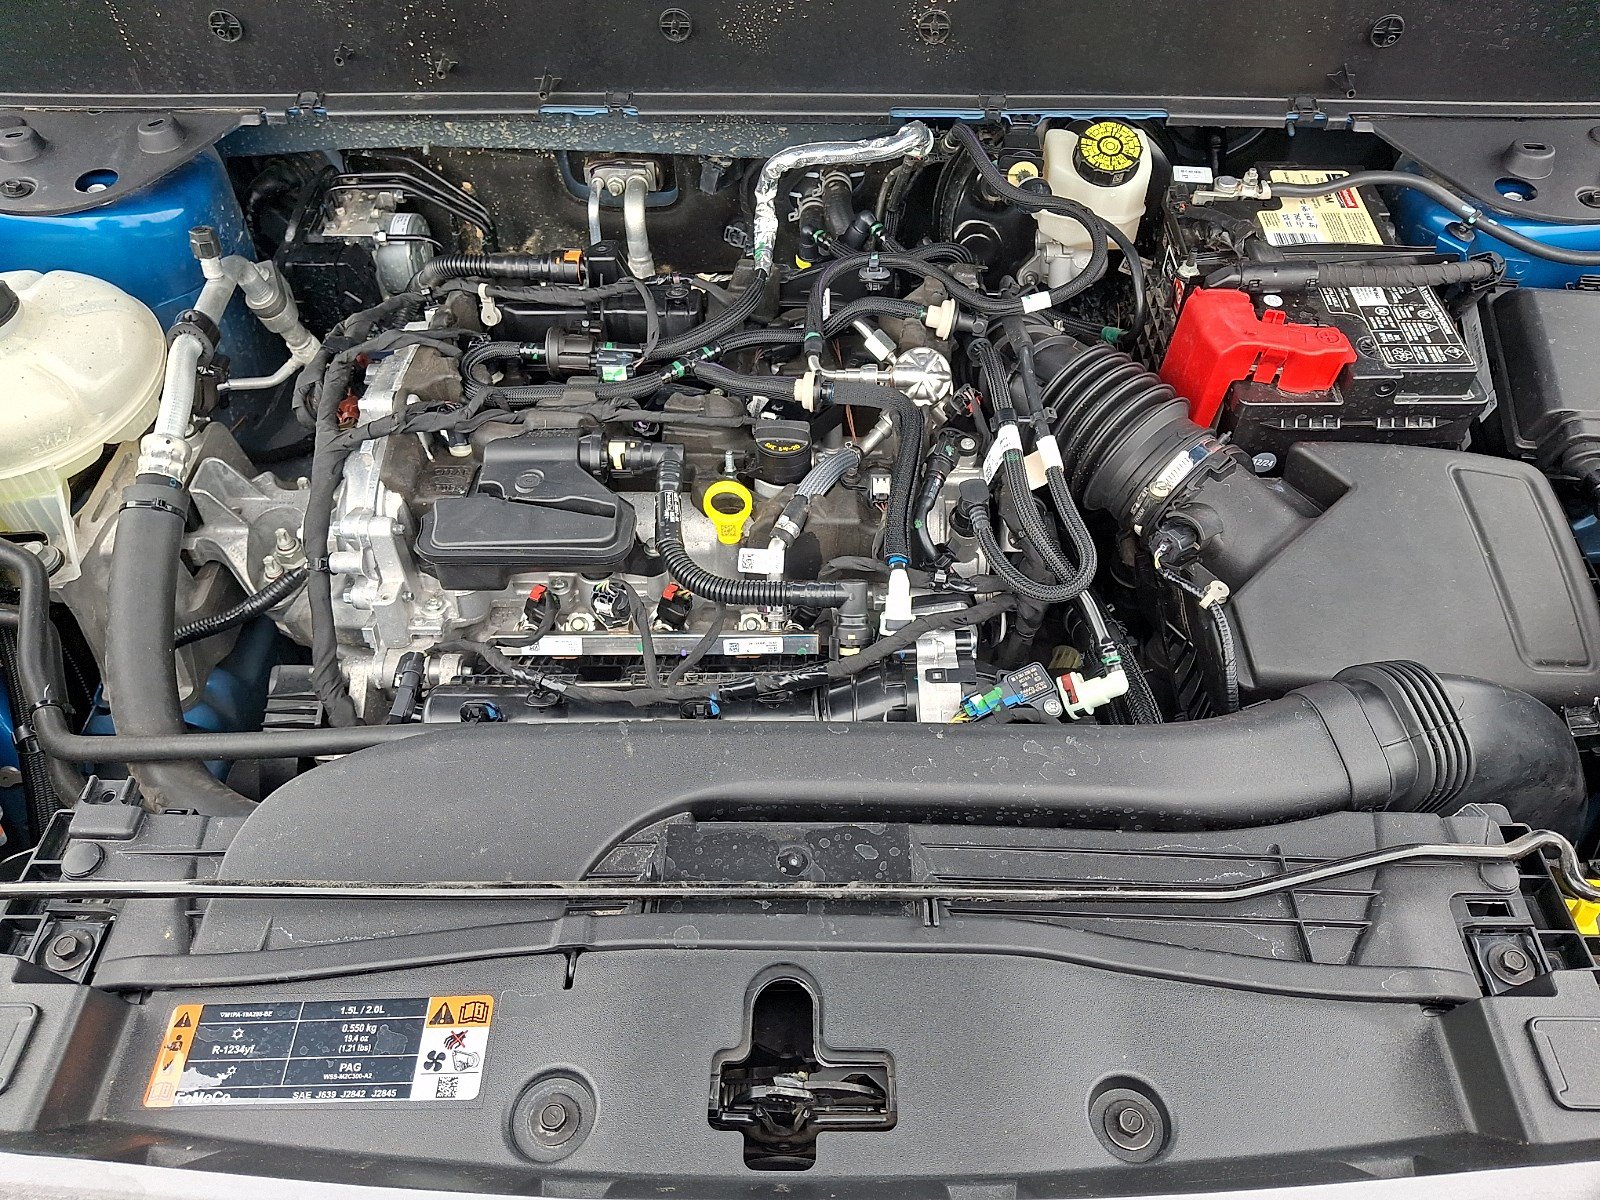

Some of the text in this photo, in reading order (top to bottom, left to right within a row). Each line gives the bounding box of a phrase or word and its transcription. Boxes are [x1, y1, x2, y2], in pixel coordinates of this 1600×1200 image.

[341, 1006, 359, 1014] 1.5L
[366, 1006, 385, 1014] 2.0L
[341, 1023, 378, 1034] 0.550 kg
[344, 1034, 359, 1042] 19.4
[212, 1044, 256, 1055] R-1234yf
[339, 1062, 362, 1072] PAG
[174, 1091, 231, 1104] FoMoCo
[293, 1089, 397, 1099] SAE J639 J2842 J2845
